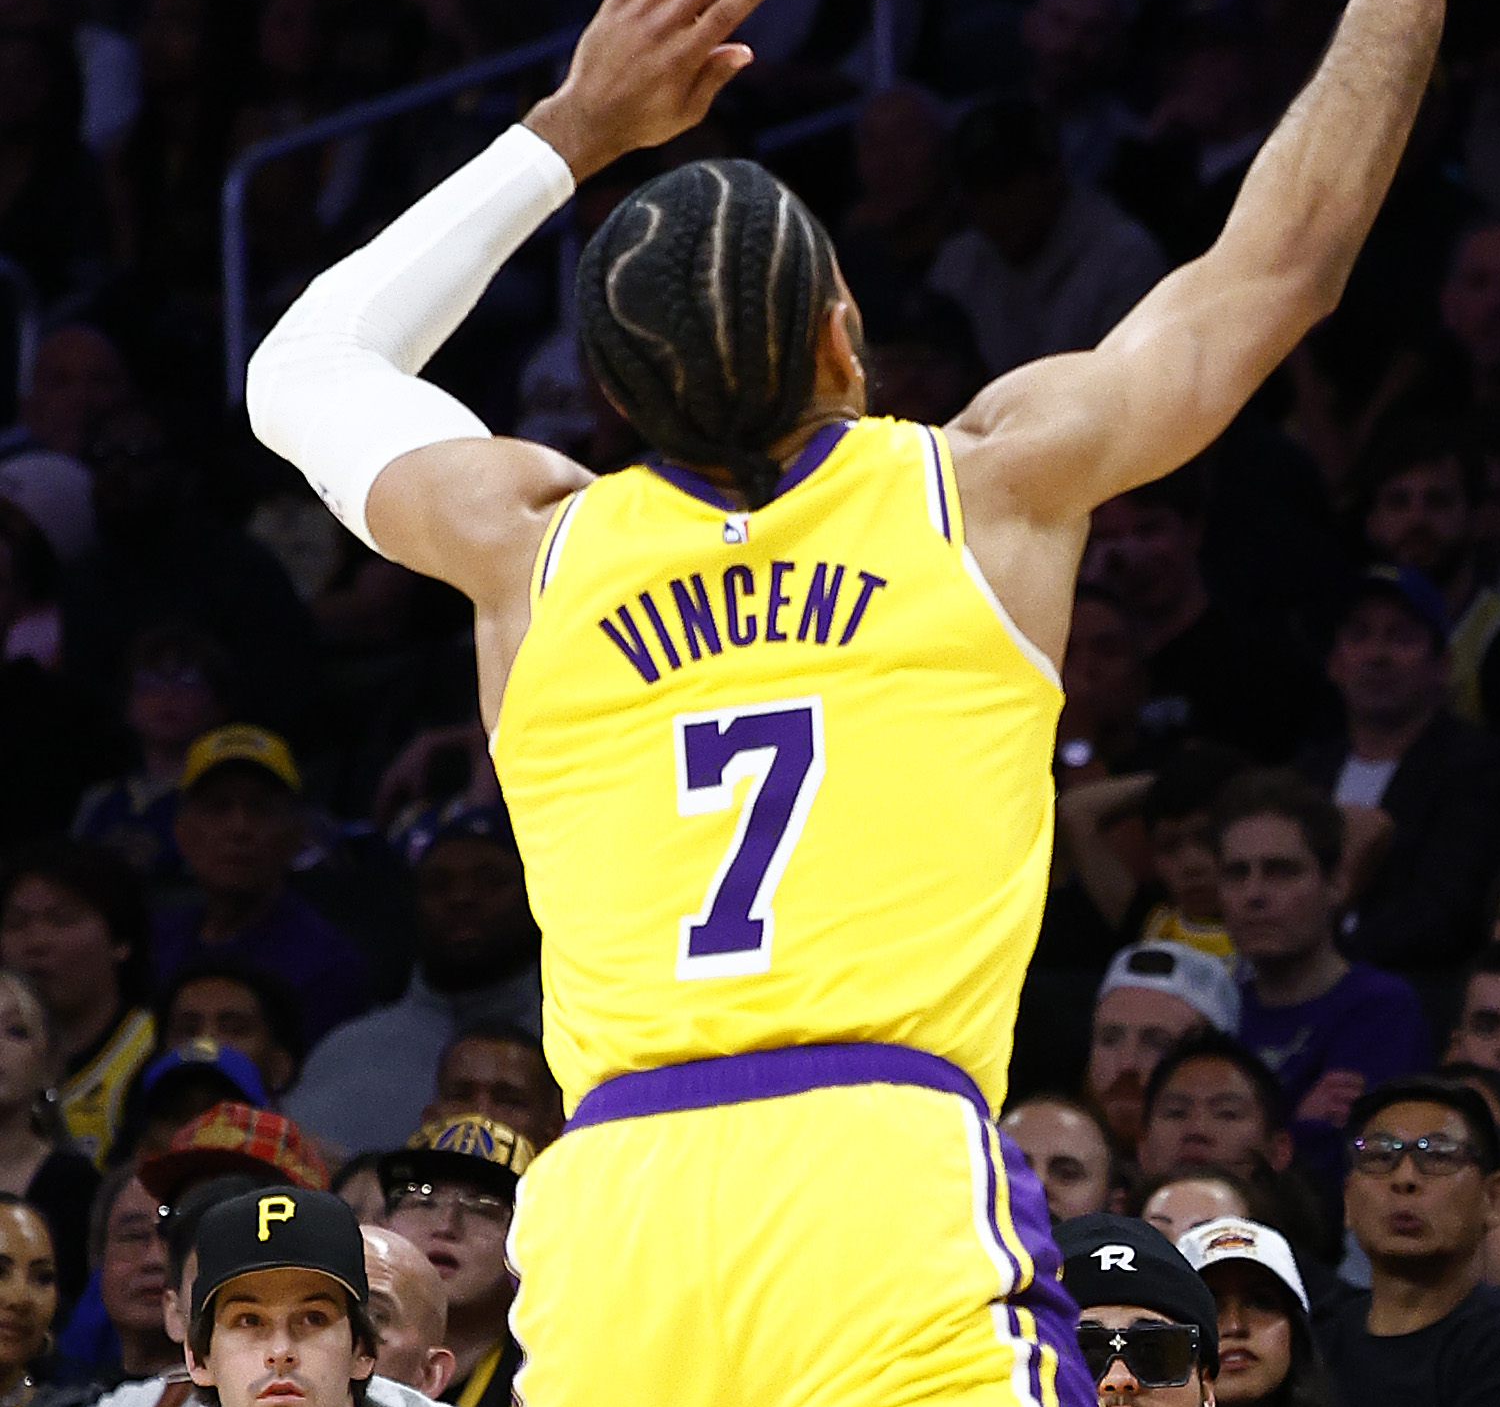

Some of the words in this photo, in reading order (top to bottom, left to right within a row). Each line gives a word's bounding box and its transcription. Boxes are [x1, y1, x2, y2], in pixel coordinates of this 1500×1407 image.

[597, 559, 888, 685] VINCENT
[675, 696, 826, 981] 7
[257, 1194, 297, 1242] P
[1089, 1244, 1139, 1272] R
